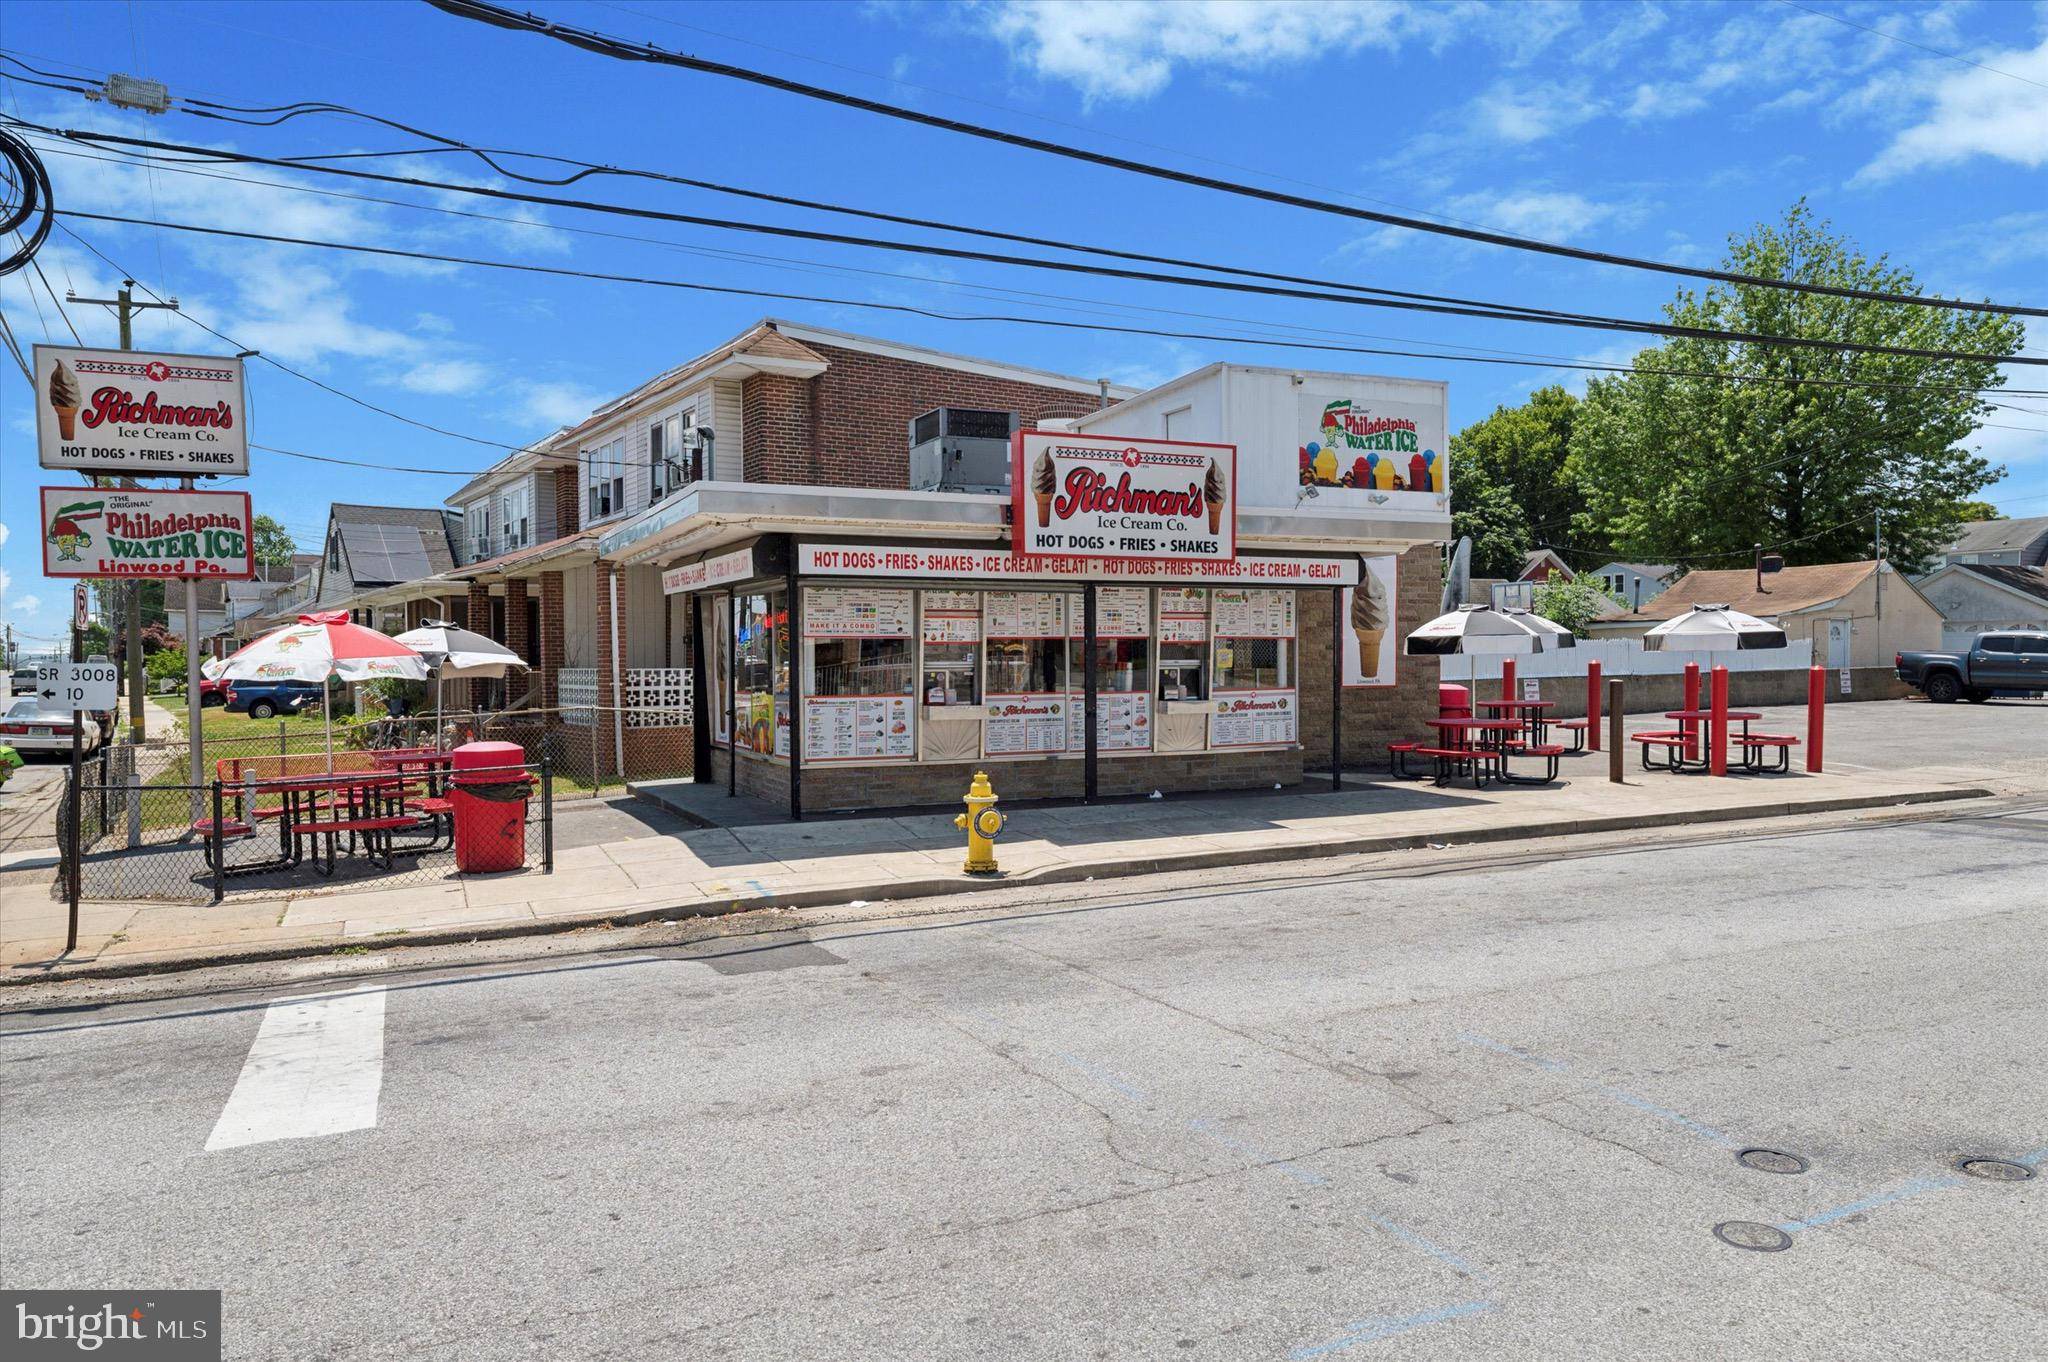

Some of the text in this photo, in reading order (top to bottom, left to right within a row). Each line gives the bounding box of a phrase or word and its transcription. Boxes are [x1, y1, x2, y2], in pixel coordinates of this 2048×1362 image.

[82, 386, 233, 430] Richman's
[118, 426, 218, 442] Ice Cream Co.
[1344, 415, 1416, 436] Philadelphia
[1345, 430, 1418, 452] WATER ICE
[61, 446, 234, 464] HOT DOGS FRIES SHAKES
[1054, 466, 1204, 520] Richman's
[105, 512, 241, 540] Philadelphia
[1097, 515, 1188, 532] Ice Cream Co.
[107, 530, 246, 558] WATER ICE
[1036, 534, 1218, 554] HOT DOGS FRIES SHAKES
[98, 559, 227, 574] Linwood Pa.
[814, 552, 1340, 578] HOT DOGS FRIES SHAKES ICE CREAM GELATI HOT DOGS FRIES SHAKES ICE CREAM GELATI
[39, 667, 116, 682] SR 3008
[66, 688, 84, 700] 10
[1002, 704, 1049, 717] Richman's
[1231, 700, 1277, 712] Richman's
